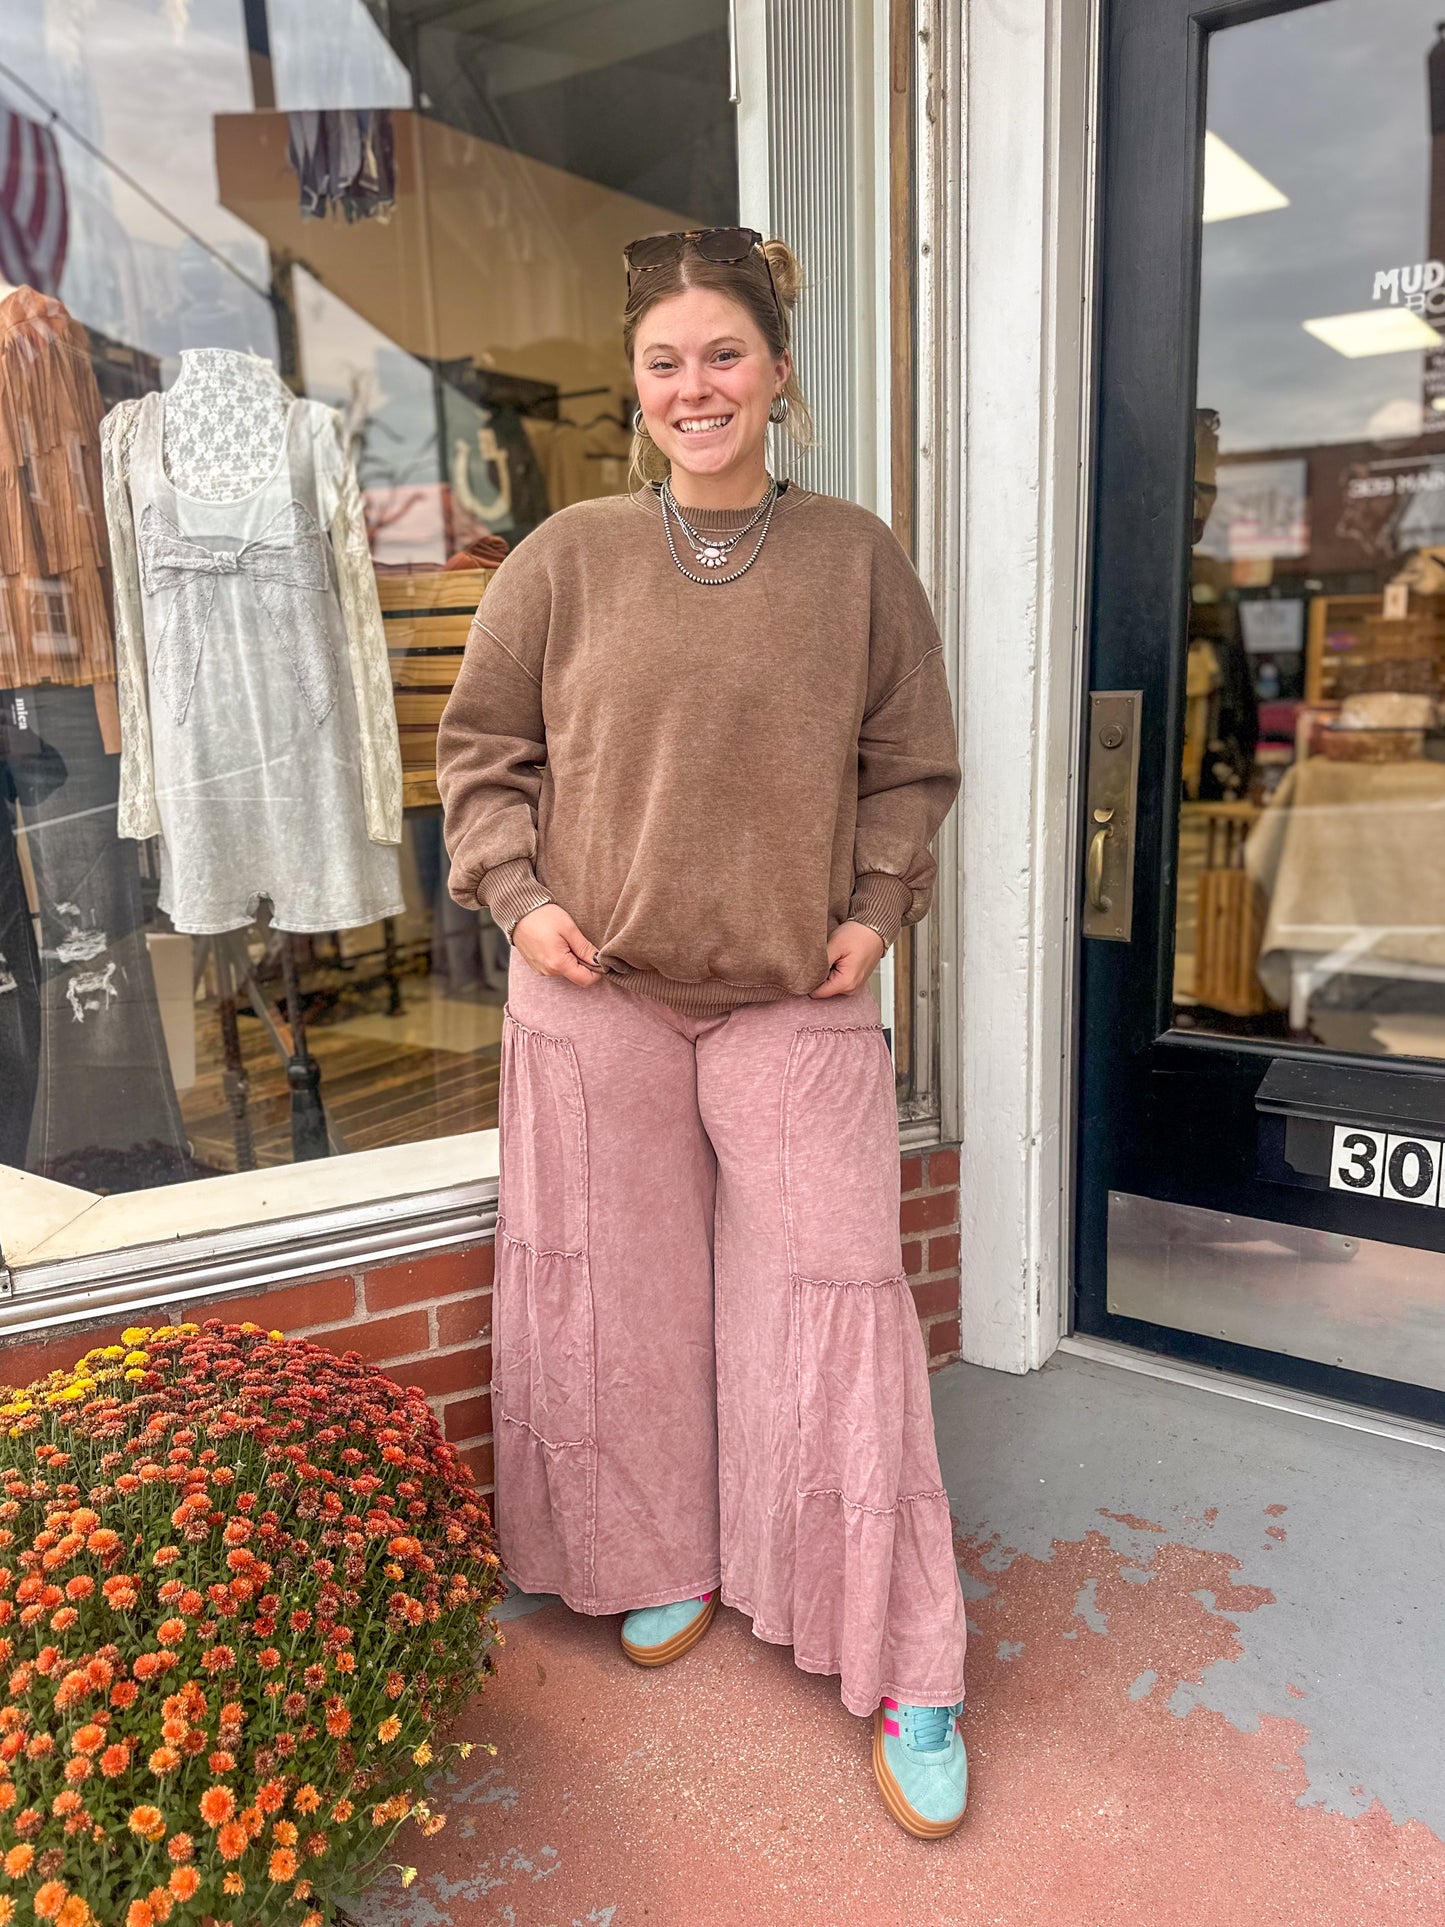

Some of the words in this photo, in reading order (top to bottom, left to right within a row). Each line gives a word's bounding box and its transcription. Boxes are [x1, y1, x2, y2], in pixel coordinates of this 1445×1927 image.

[1372, 261, 1445, 304] MUD
[15, 698, 28, 730] mica
[1338, 1133, 1434, 1198] 30
